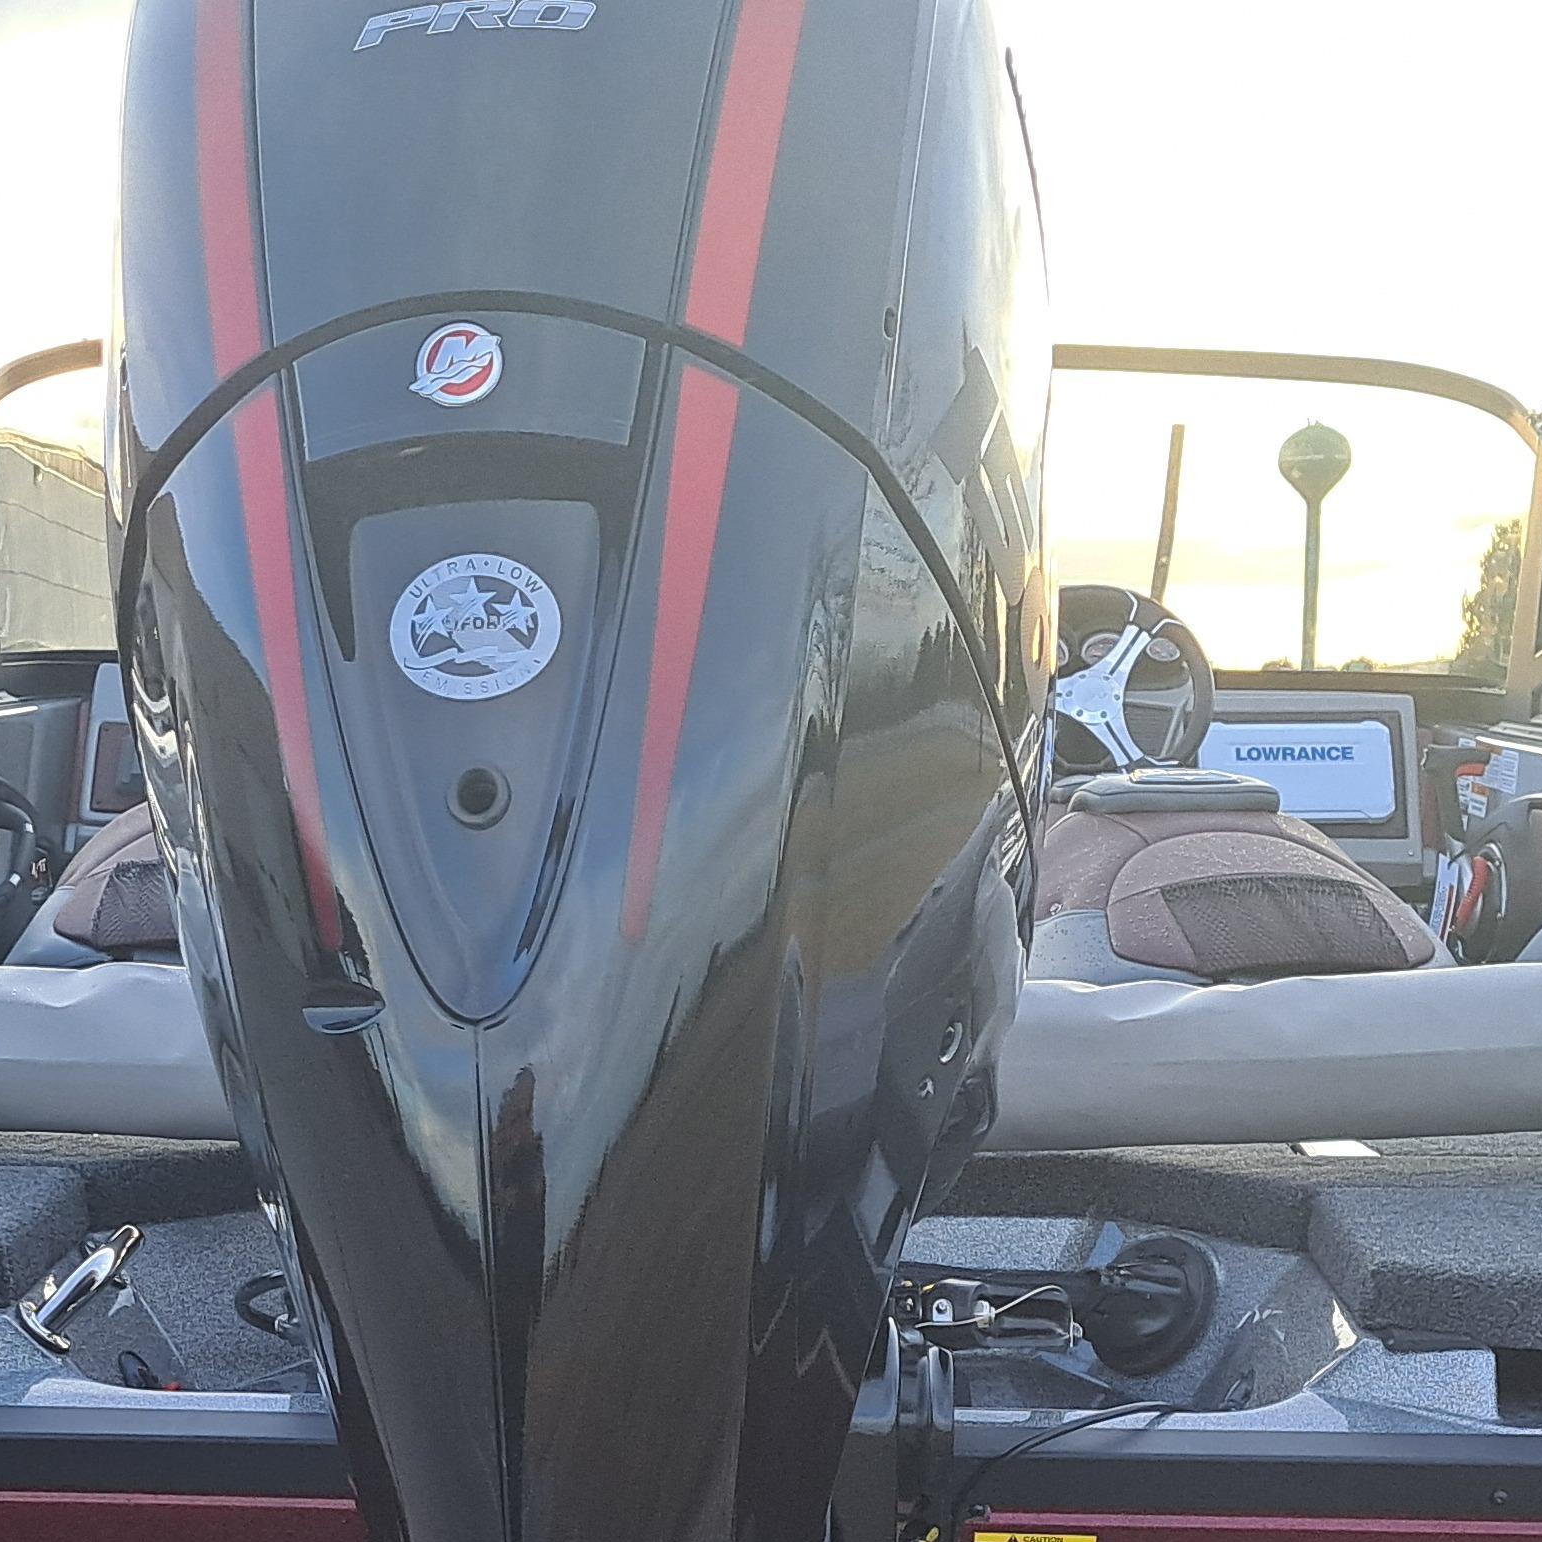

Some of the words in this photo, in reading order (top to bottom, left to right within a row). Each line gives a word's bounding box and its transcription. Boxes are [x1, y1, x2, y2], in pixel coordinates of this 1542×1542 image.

[352, 0, 597, 52] PRO
[409, 558, 477, 600] ULTRA
[497, 560, 544, 595] LOW
[1235, 746, 1355, 761] LOWRANCE
